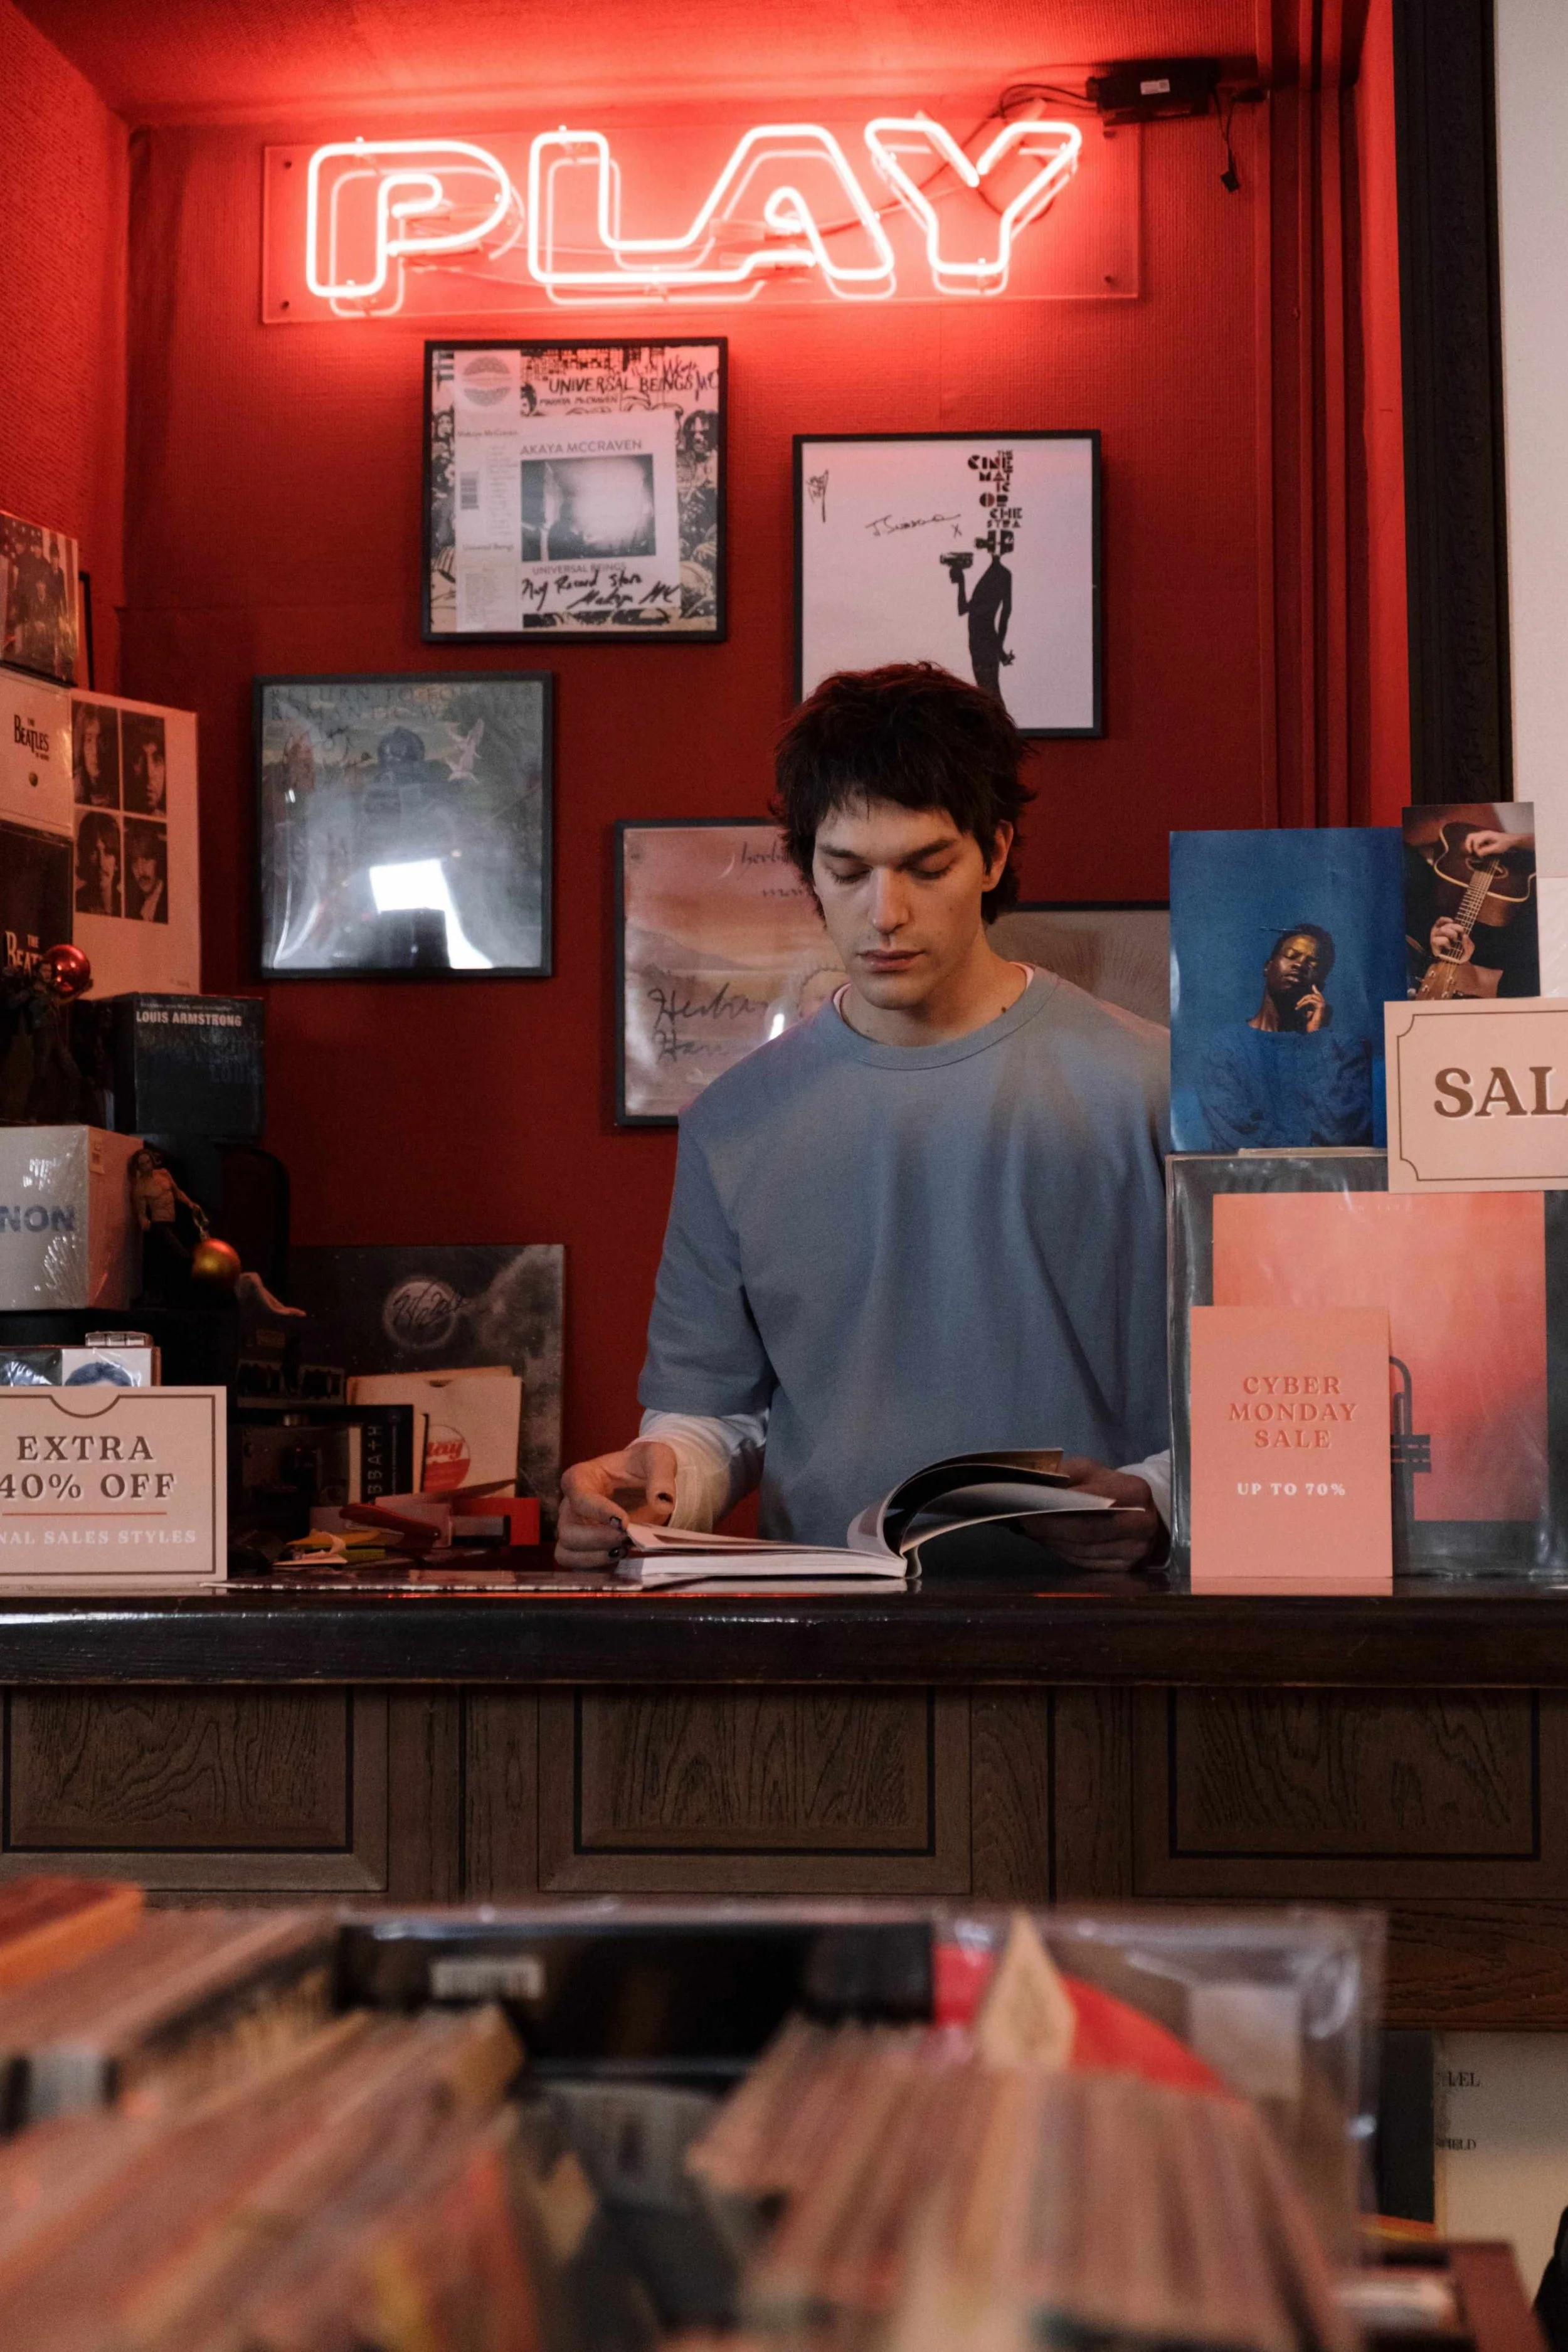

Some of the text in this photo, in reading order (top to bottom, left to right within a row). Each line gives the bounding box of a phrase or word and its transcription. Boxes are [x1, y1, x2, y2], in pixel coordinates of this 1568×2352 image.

[305, 118, 1082, 306] PLAY
[549, 374, 693, 395] UNIVERSAL BEINGS
[566, 440, 642, 453] MCCRAVEN
[532, 564, 587, 576] UNIVERSAL
[14, 714, 50, 753] BEATLES
[5, 931, 44, 978] BEAT
[135, 1010, 243, 1027] LOUIS ARMSTRONG
[1243, 1376, 1342, 1396] CYBER
[1229, 1403, 1358, 1422] MONDAY
[1254, 1429, 1332, 1448] SALE
[17, 1436, 154, 1462] EXTRA
[0, 1473, 176, 1500] 40% OFF
[1236, 1483, 1346, 1496] UP TO 70%
[44, 1530, 109, 1545] SALES
[117, 1529, 197, 1545] STYLES
